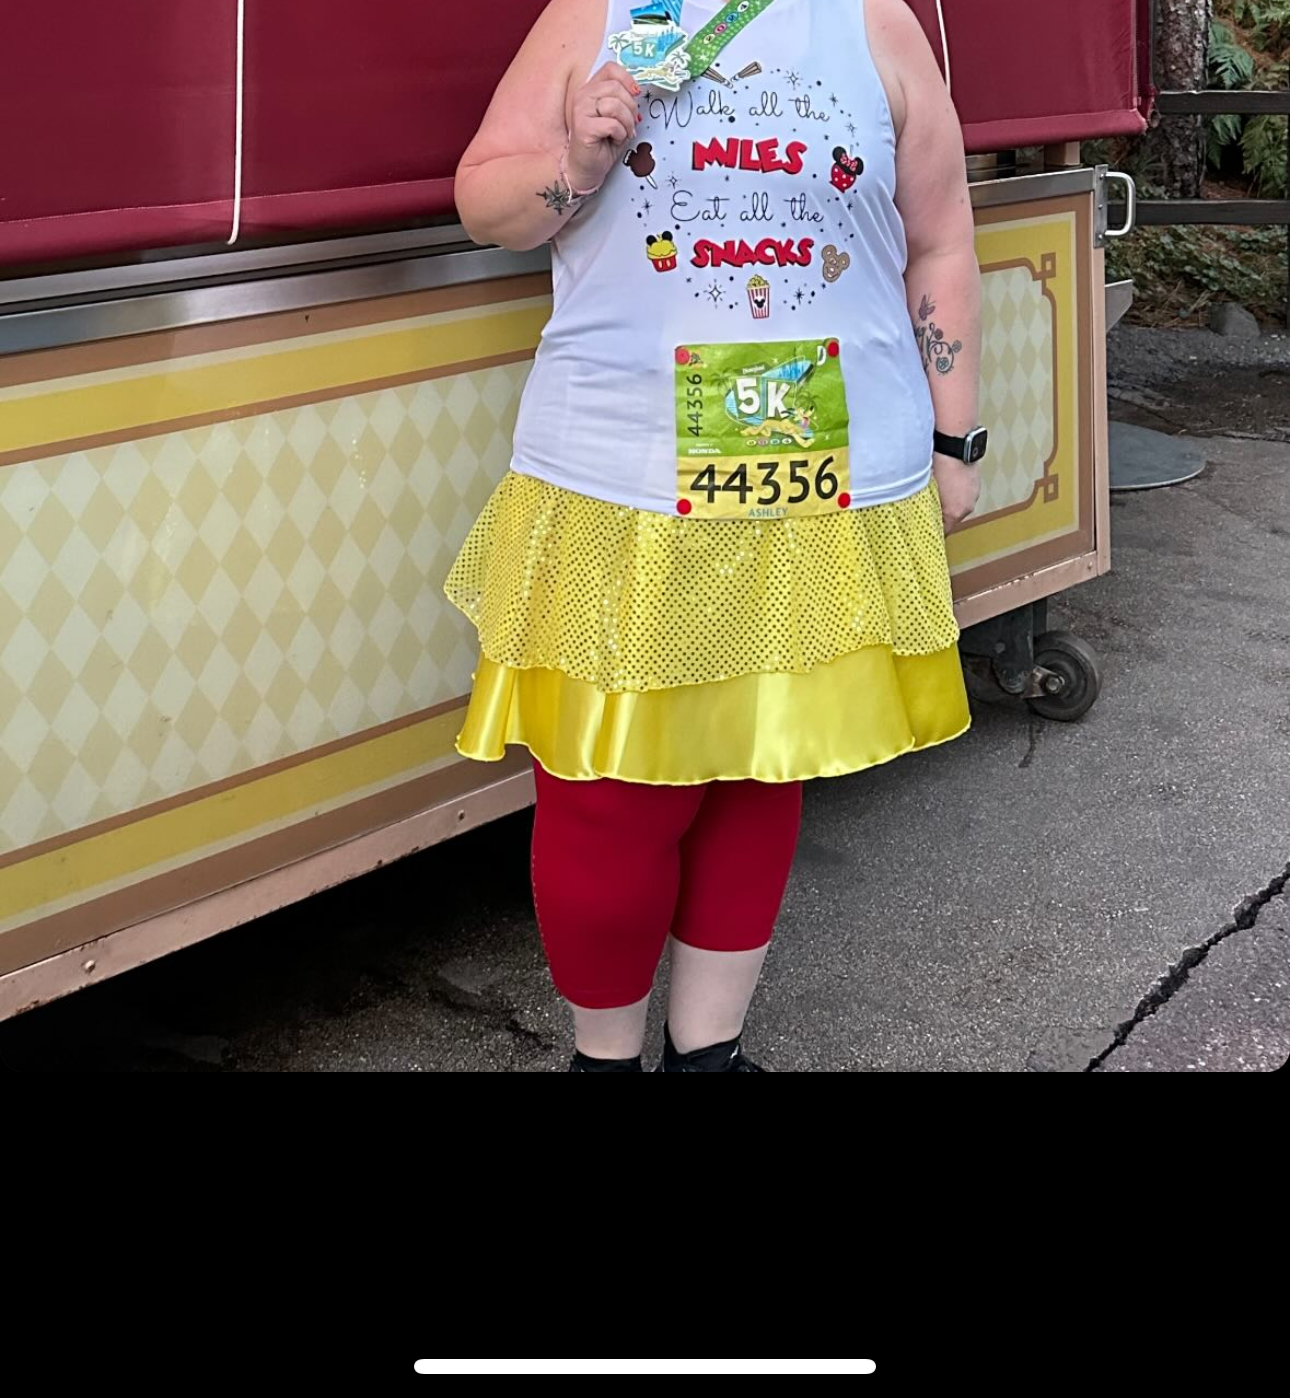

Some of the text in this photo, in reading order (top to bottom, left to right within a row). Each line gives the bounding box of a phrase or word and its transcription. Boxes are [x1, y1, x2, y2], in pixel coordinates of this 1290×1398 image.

[649, 89, 830, 129] Walk all the
[692, 137, 808, 175] MILES
[670, 190, 825, 223] Eat all the
[690, 238, 815, 268] SNACKS
[686, 373, 703, 437] 44356
[690, 455, 838, 505] 44356
[748, 507, 789, 518] ASHLEY
